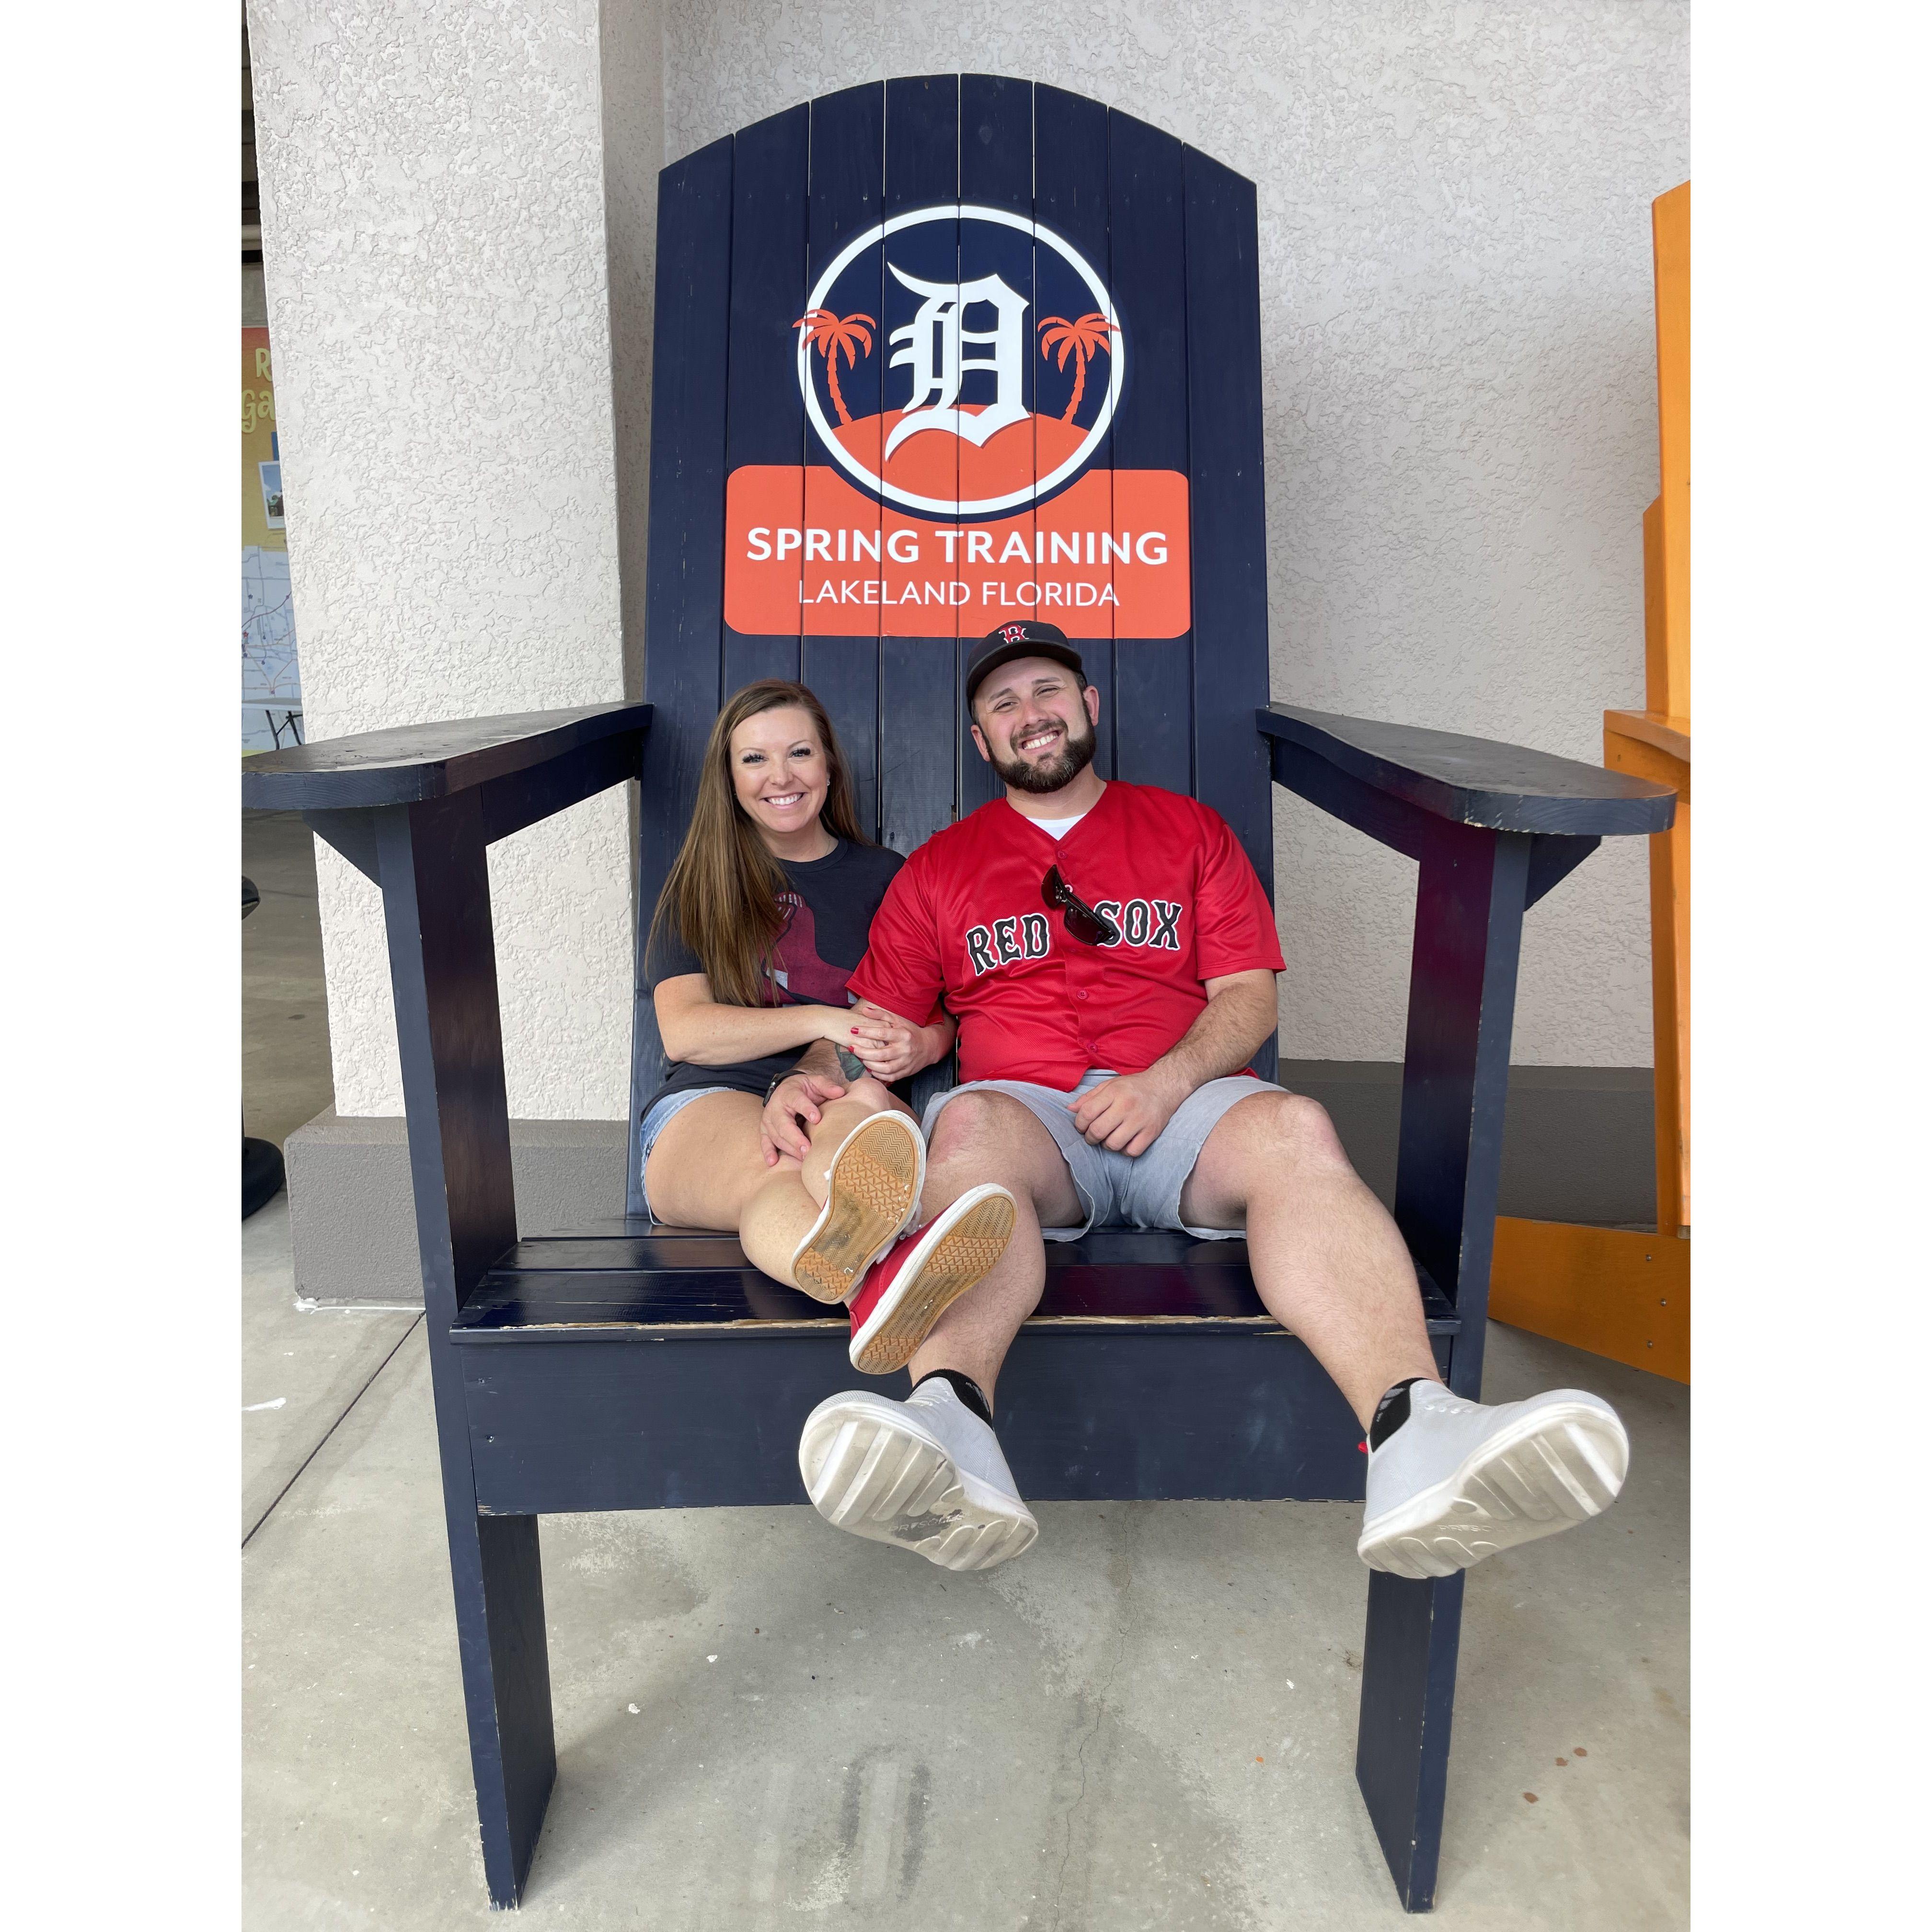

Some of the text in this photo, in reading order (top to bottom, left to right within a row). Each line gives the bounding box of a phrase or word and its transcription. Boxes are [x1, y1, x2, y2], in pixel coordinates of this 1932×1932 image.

[885, 262, 1031, 461] D
[747, 527, 1167, 565] SPRING TRAINING
[799, 580, 1120, 606] LAKELAND FLORIDA
[998, 624, 1029, 644] B
[966, 898, 1182, 976] RED SOX
